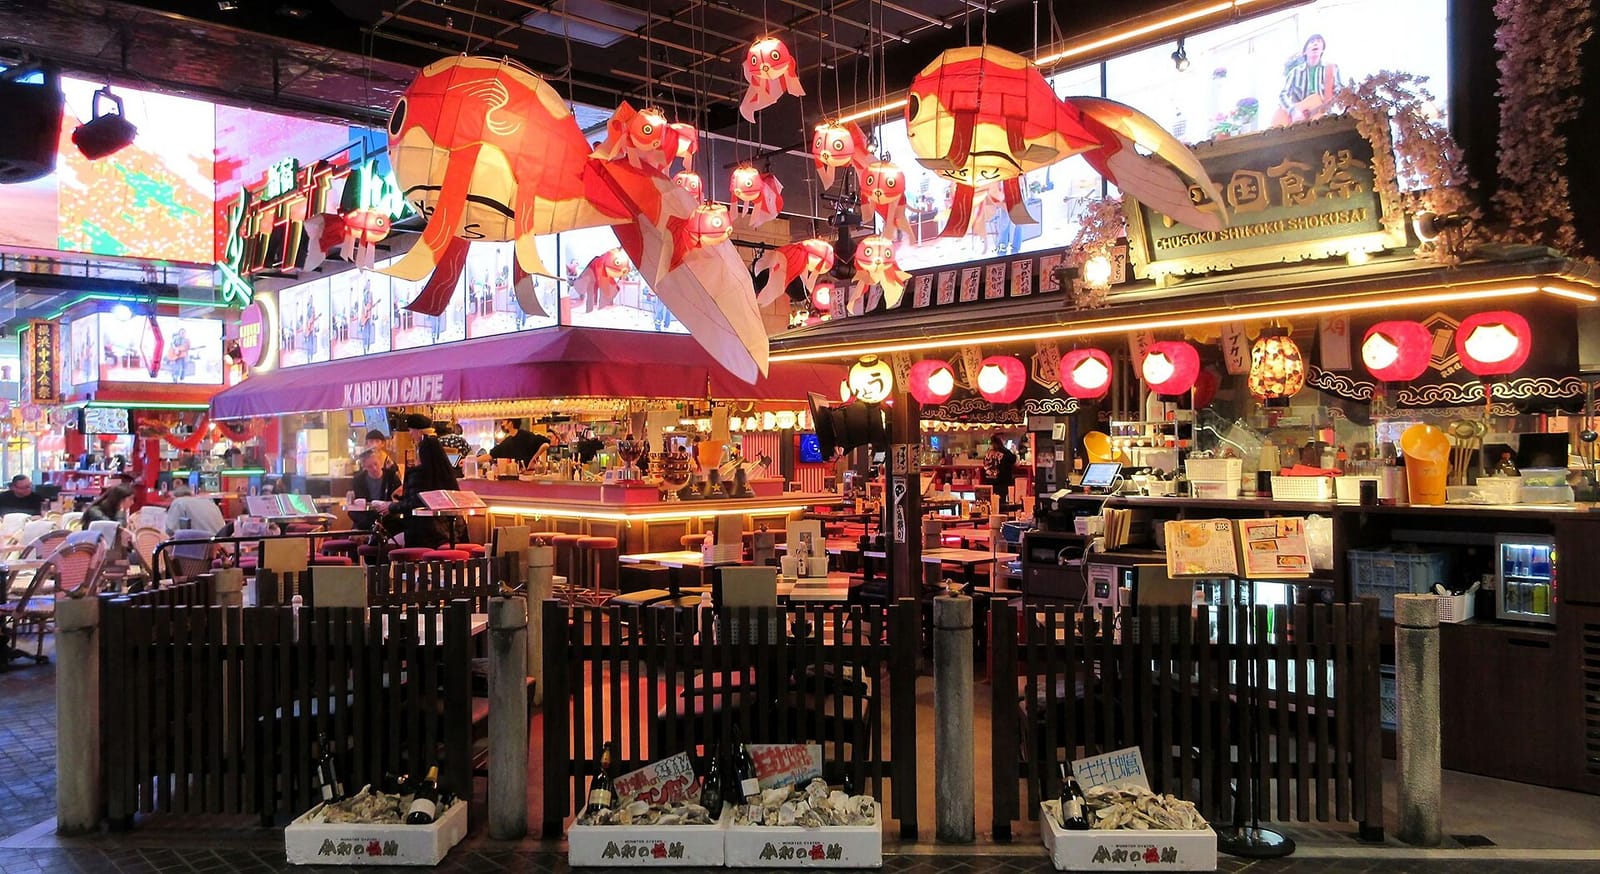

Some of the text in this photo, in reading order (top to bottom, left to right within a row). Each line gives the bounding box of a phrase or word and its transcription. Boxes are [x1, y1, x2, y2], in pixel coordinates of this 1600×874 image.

[1155, 207, 1369, 250] CHUGOKU SHIKOKU SHOKUSAI
[342, 373, 444, 409] KABUKI CAFE
